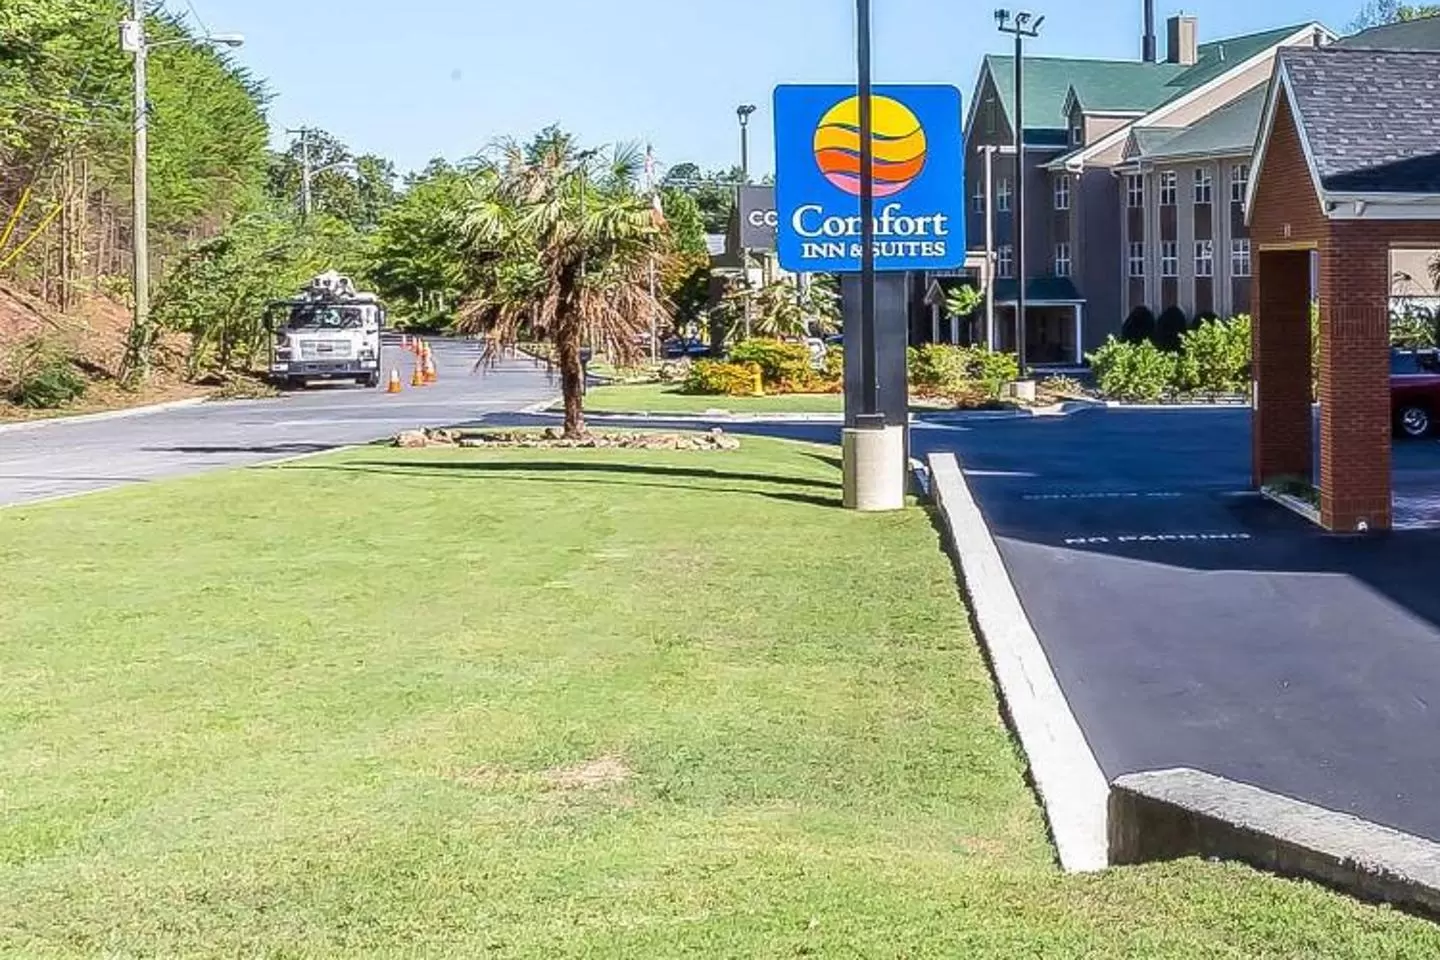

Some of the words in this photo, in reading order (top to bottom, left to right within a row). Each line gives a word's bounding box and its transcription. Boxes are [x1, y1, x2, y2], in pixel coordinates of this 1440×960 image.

[792, 203, 949, 237] Comfort
[802, 242, 845, 258] INN
[850, 244, 862, 257] &
[872, 241, 945, 257] SUITES
